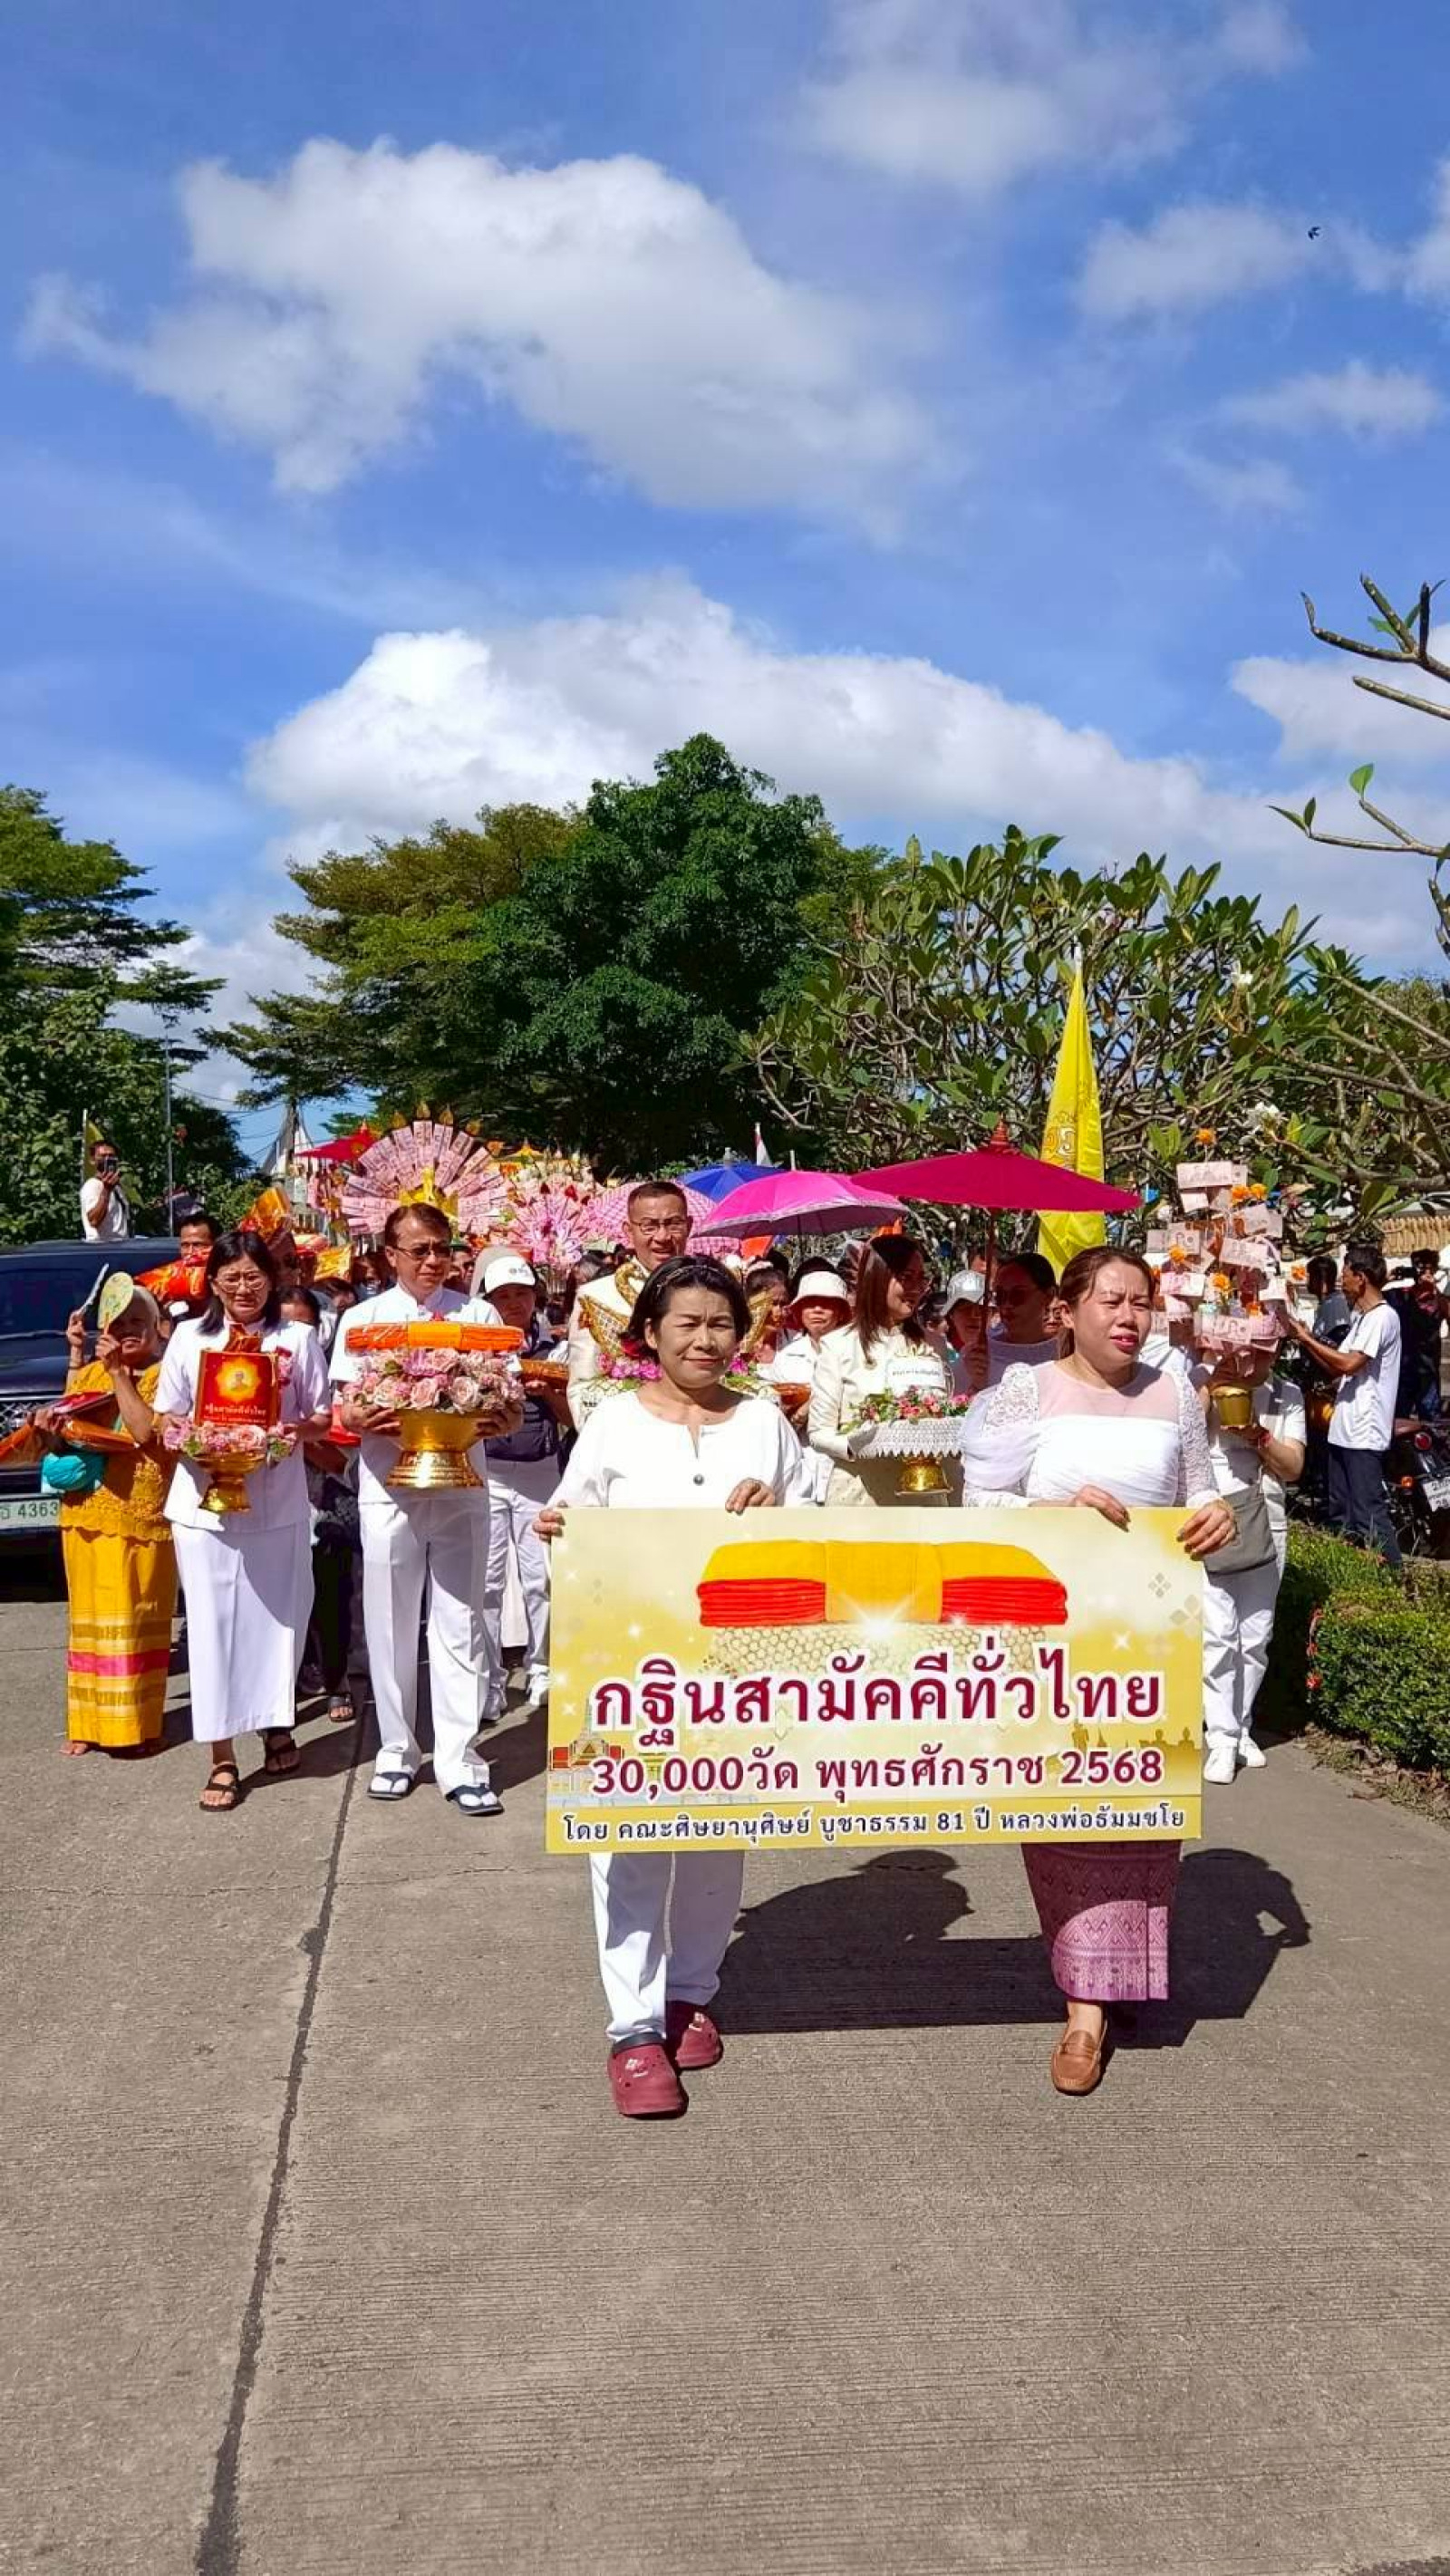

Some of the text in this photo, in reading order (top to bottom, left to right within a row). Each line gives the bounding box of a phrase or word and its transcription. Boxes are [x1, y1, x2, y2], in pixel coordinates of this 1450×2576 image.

[18, 1501, 59, 1519] 4363
[594, 1635, 1160, 1747] กฐินสามัคคีทั่วไทย
[592, 1742, 1163, 1804] 30,000วัด พุทธศักราช 2568
[564, 1802, 1184, 1843] โดย คณะศิษยานุศิษย์ บูชาธรรม 81 ปี หลวงพ่อธัมมชโย
